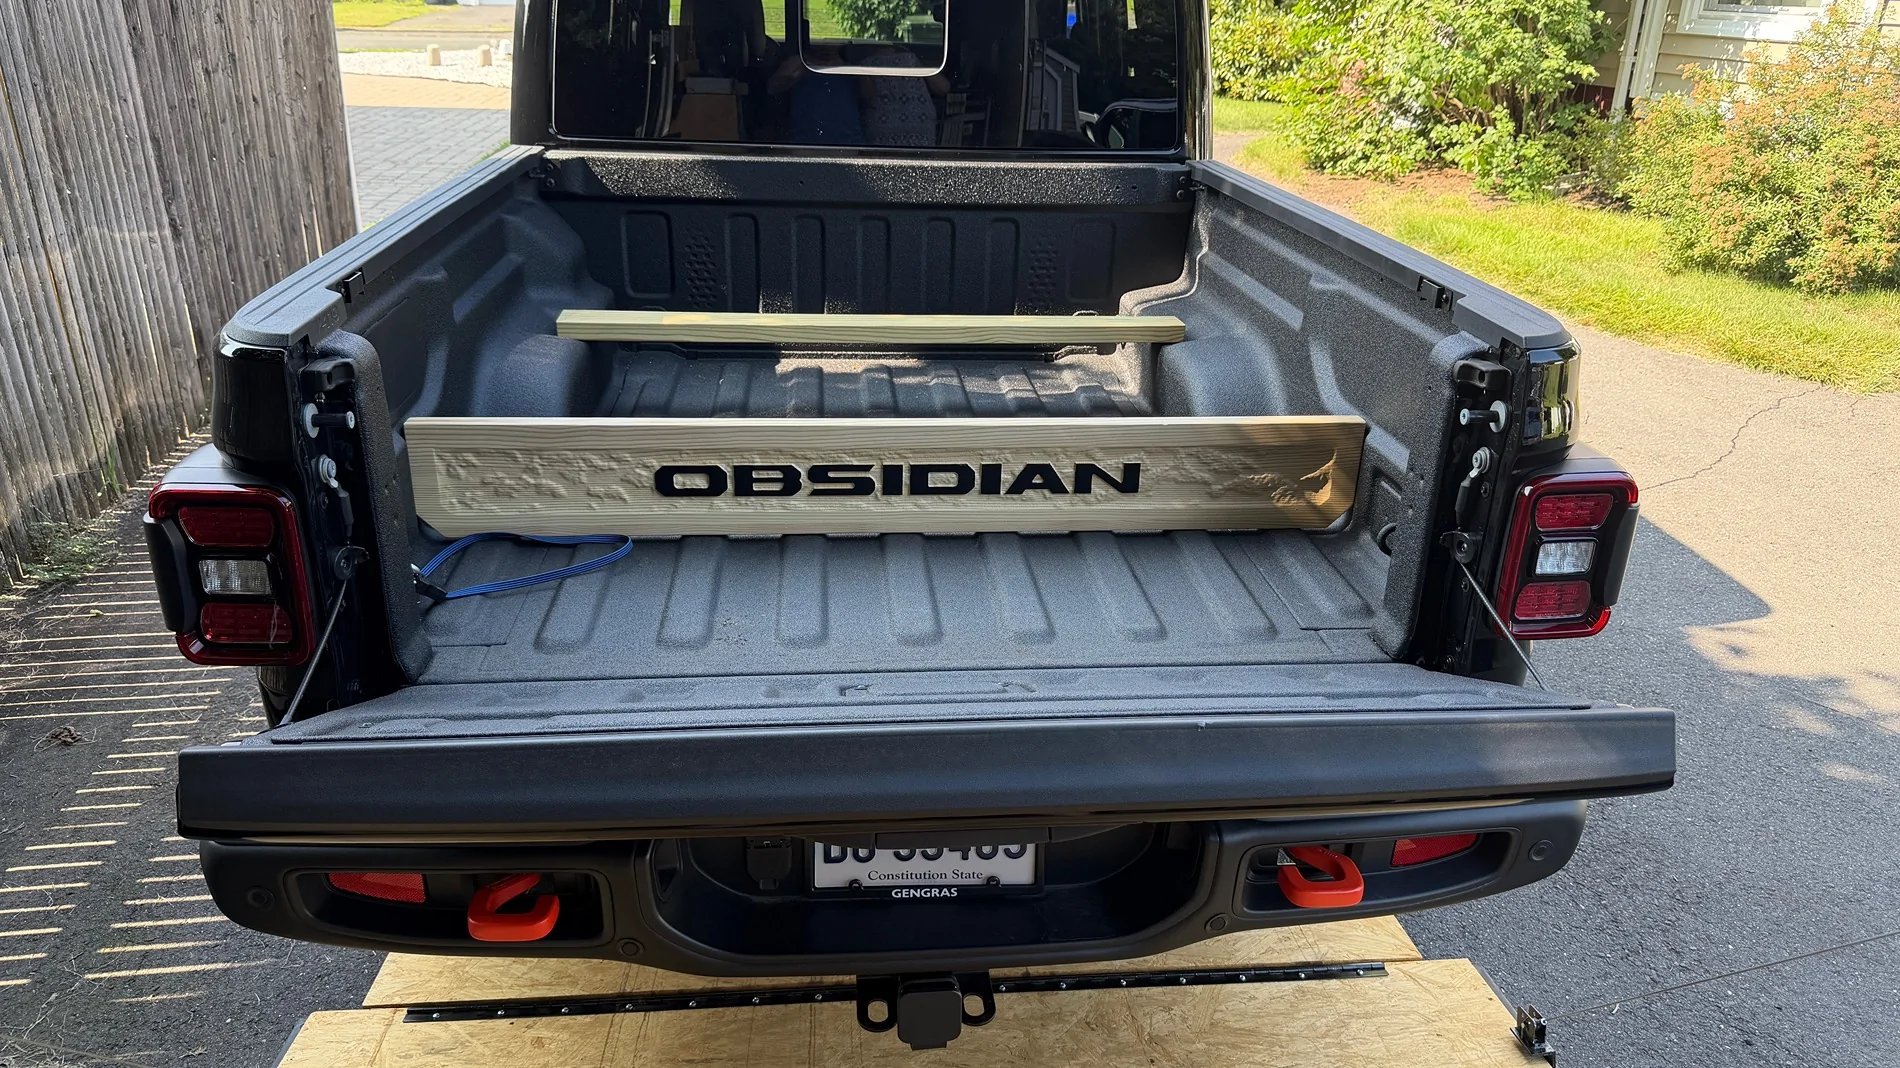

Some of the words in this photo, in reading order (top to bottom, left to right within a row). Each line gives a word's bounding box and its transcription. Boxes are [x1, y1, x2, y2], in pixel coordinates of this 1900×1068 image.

[654, 462, 1141, 498] OBSIDIAN
[867, 869, 947, 881] Constitution
[951, 868, 984, 880] State
[891, 887, 958, 898] GENGRAS
